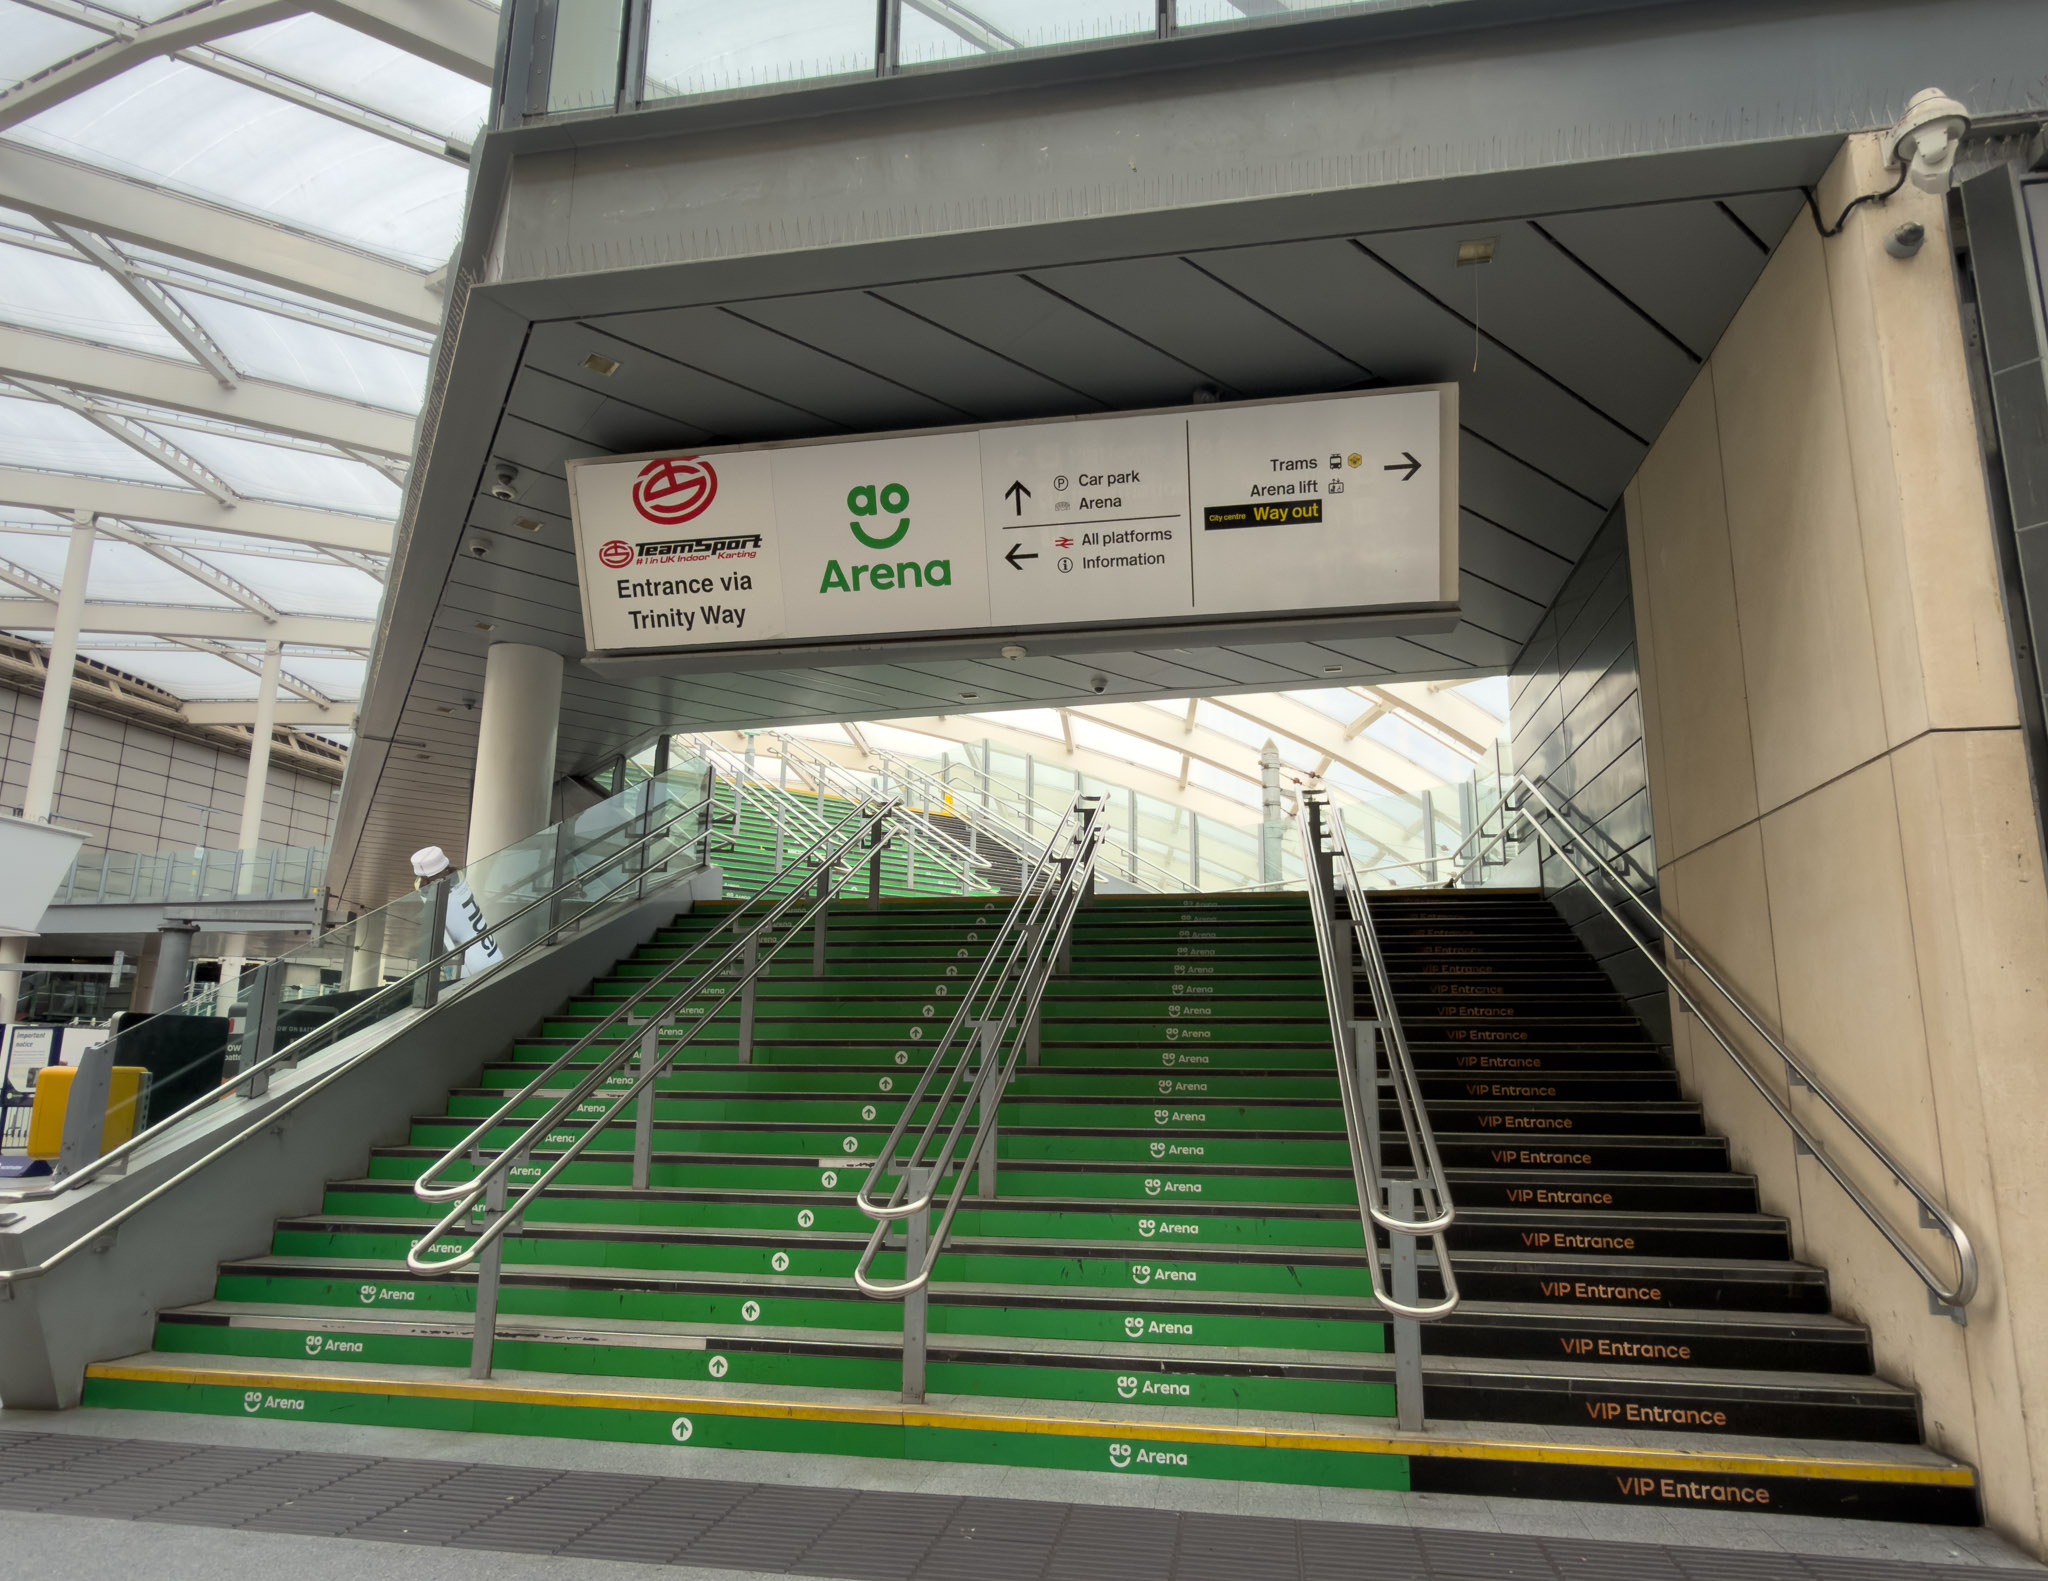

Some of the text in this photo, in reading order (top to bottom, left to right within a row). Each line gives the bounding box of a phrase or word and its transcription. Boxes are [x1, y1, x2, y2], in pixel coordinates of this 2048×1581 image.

[1270, 458, 1318, 472] Trams
[1079, 474, 1103, 487] Car
[1107, 470, 1140, 487] park
[1250, 480, 1318, 497] Arena lift
[1079, 497, 1122, 510] Arena
[1209, 503, 1319, 522] City centre Way out
[1082, 529, 1172, 547] All platforms
[635, 534, 763, 557] TeamSport
[660, 555, 675, 563] UK
[677, 554, 710, 562] Indoor
[717, 551, 757, 560] Karting
[1082, 553, 1165, 569] Information
[819, 559, 952, 593] Arena
[617, 571, 752, 599] Entrance via
[628, 605, 746, 631] Trinity Way
[1183, 1007, 1211, 1015] Arena
[1437, 1007, 1514, 1016] VIP Entrance
[658, 1028, 683, 1036] Arena
[1181, 1030, 1211, 1038] Arena
[1446, 1030, 1528, 1040] VIP Entrance
[1178, 1054, 1209, 1063] Arena
[1456, 1056, 1541, 1067] VIP Entrance
[606, 1076, 634, 1085] Arena
[1175, 1082, 1207, 1091] Arena
[1466, 1085, 1556, 1096] VIP Entrance
[576, 1104, 606, 1113] Arena
[1172, 1112, 1206, 1121] Arena
[1478, 1116, 1573, 1129] VIP Entrance
[1168, 1145, 1204, 1155] Arena
[1491, 1150, 1592, 1164] VIP Entrance
[510, 1166, 542, 1176] Arena
[1164, 1181, 1202, 1193] Arena
[1506, 1189, 1613, 1204] VIP Entrance
[1159, 1222, 1199, 1234] Arena
[1521, 1233, 1635, 1249] VIP Entrance
[428, 1244, 462, 1253] Arena
[1154, 1269, 1197, 1281] Arena
[379, 1288, 415, 1301] Arena
[1540, 1281, 1661, 1300] VIP Entrance
[1148, 1321, 1193, 1335] Arena
[325, 1339, 363, 1352] Arena
[1560, 1338, 1691, 1359] VIP Entrance
[1142, 1380, 1190, 1395] Arena
[264, 1395, 305, 1410] Arena
[1586, 1401, 1727, 1426] VIP Entrance
[1136, 1449, 1188, 1466] Arena
[1616, 1476, 1770, 1504] VIP Entrance
